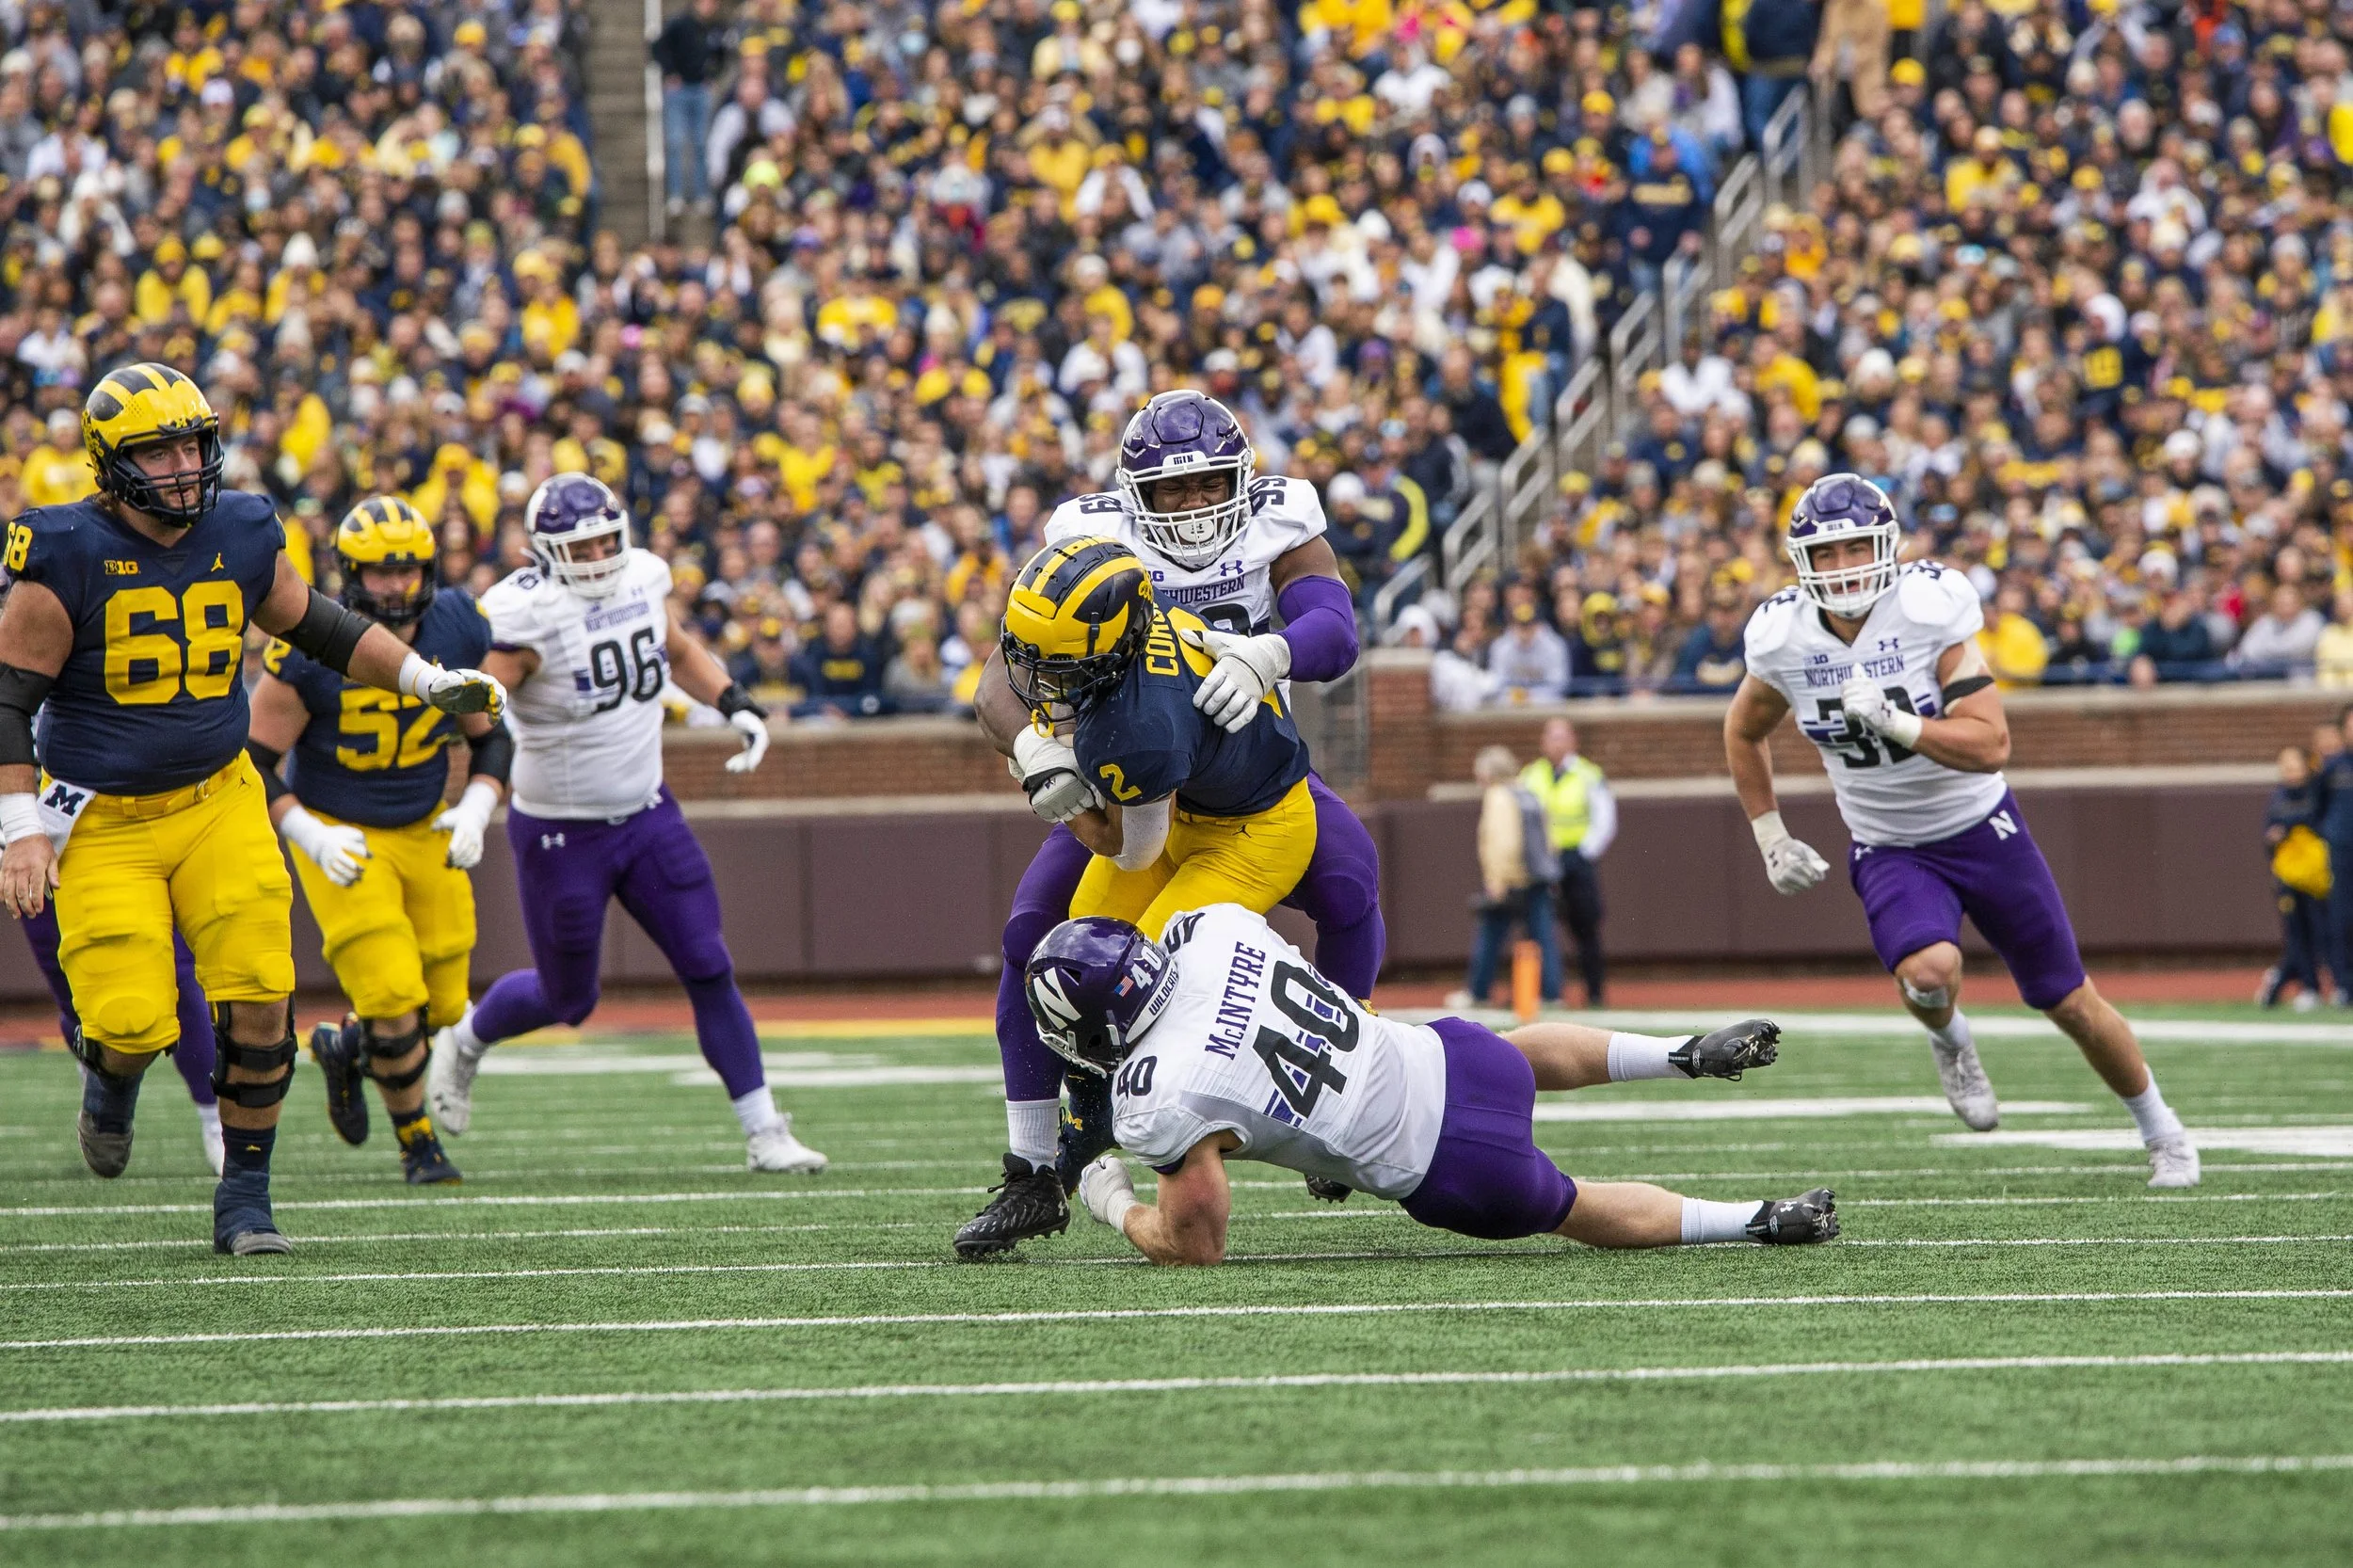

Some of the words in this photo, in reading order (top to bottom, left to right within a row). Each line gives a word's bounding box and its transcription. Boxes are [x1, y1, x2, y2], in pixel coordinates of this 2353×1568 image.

[104, 580, 244, 704] 68
[591, 626, 663, 713] 96
[336, 687, 450, 772] 52
[43, 784, 86, 817] M
[1099, 763, 1142, 801] 2
[1988, 810, 2018, 840] N
[1033, 970, 1082, 1031] N
[1147, 968, 1179, 1016] WILDCATS
[1205, 941, 1266, 1061] McINTYRE
[1252, 960, 1360, 1119] 40
[1116, 1055, 1158, 1100] 40
